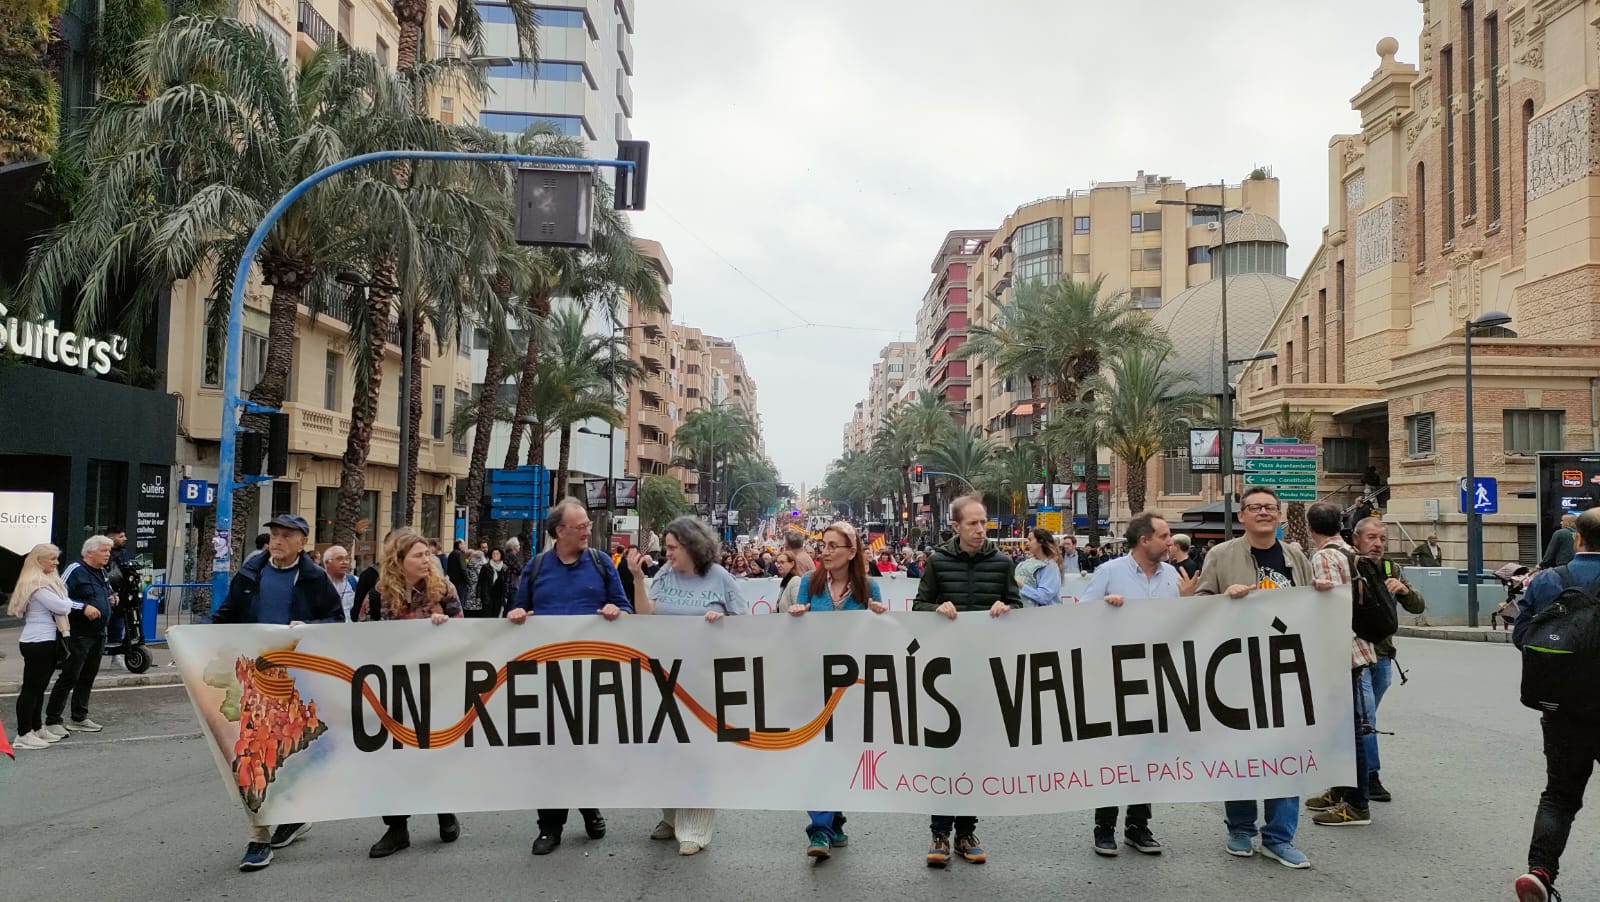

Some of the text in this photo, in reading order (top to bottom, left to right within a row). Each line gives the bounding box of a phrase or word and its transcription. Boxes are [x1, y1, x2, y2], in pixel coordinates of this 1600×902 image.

[141, 483, 165, 494] Suiters
[0, 512, 48, 524] Suiters
[351, 616, 1316, 753] ON RENAIX EL PAÍS VALENCIÀ
[895, 749, 1318, 796] ACCIÓ CULTURAL DEL PAÍS VALENCIÀ
